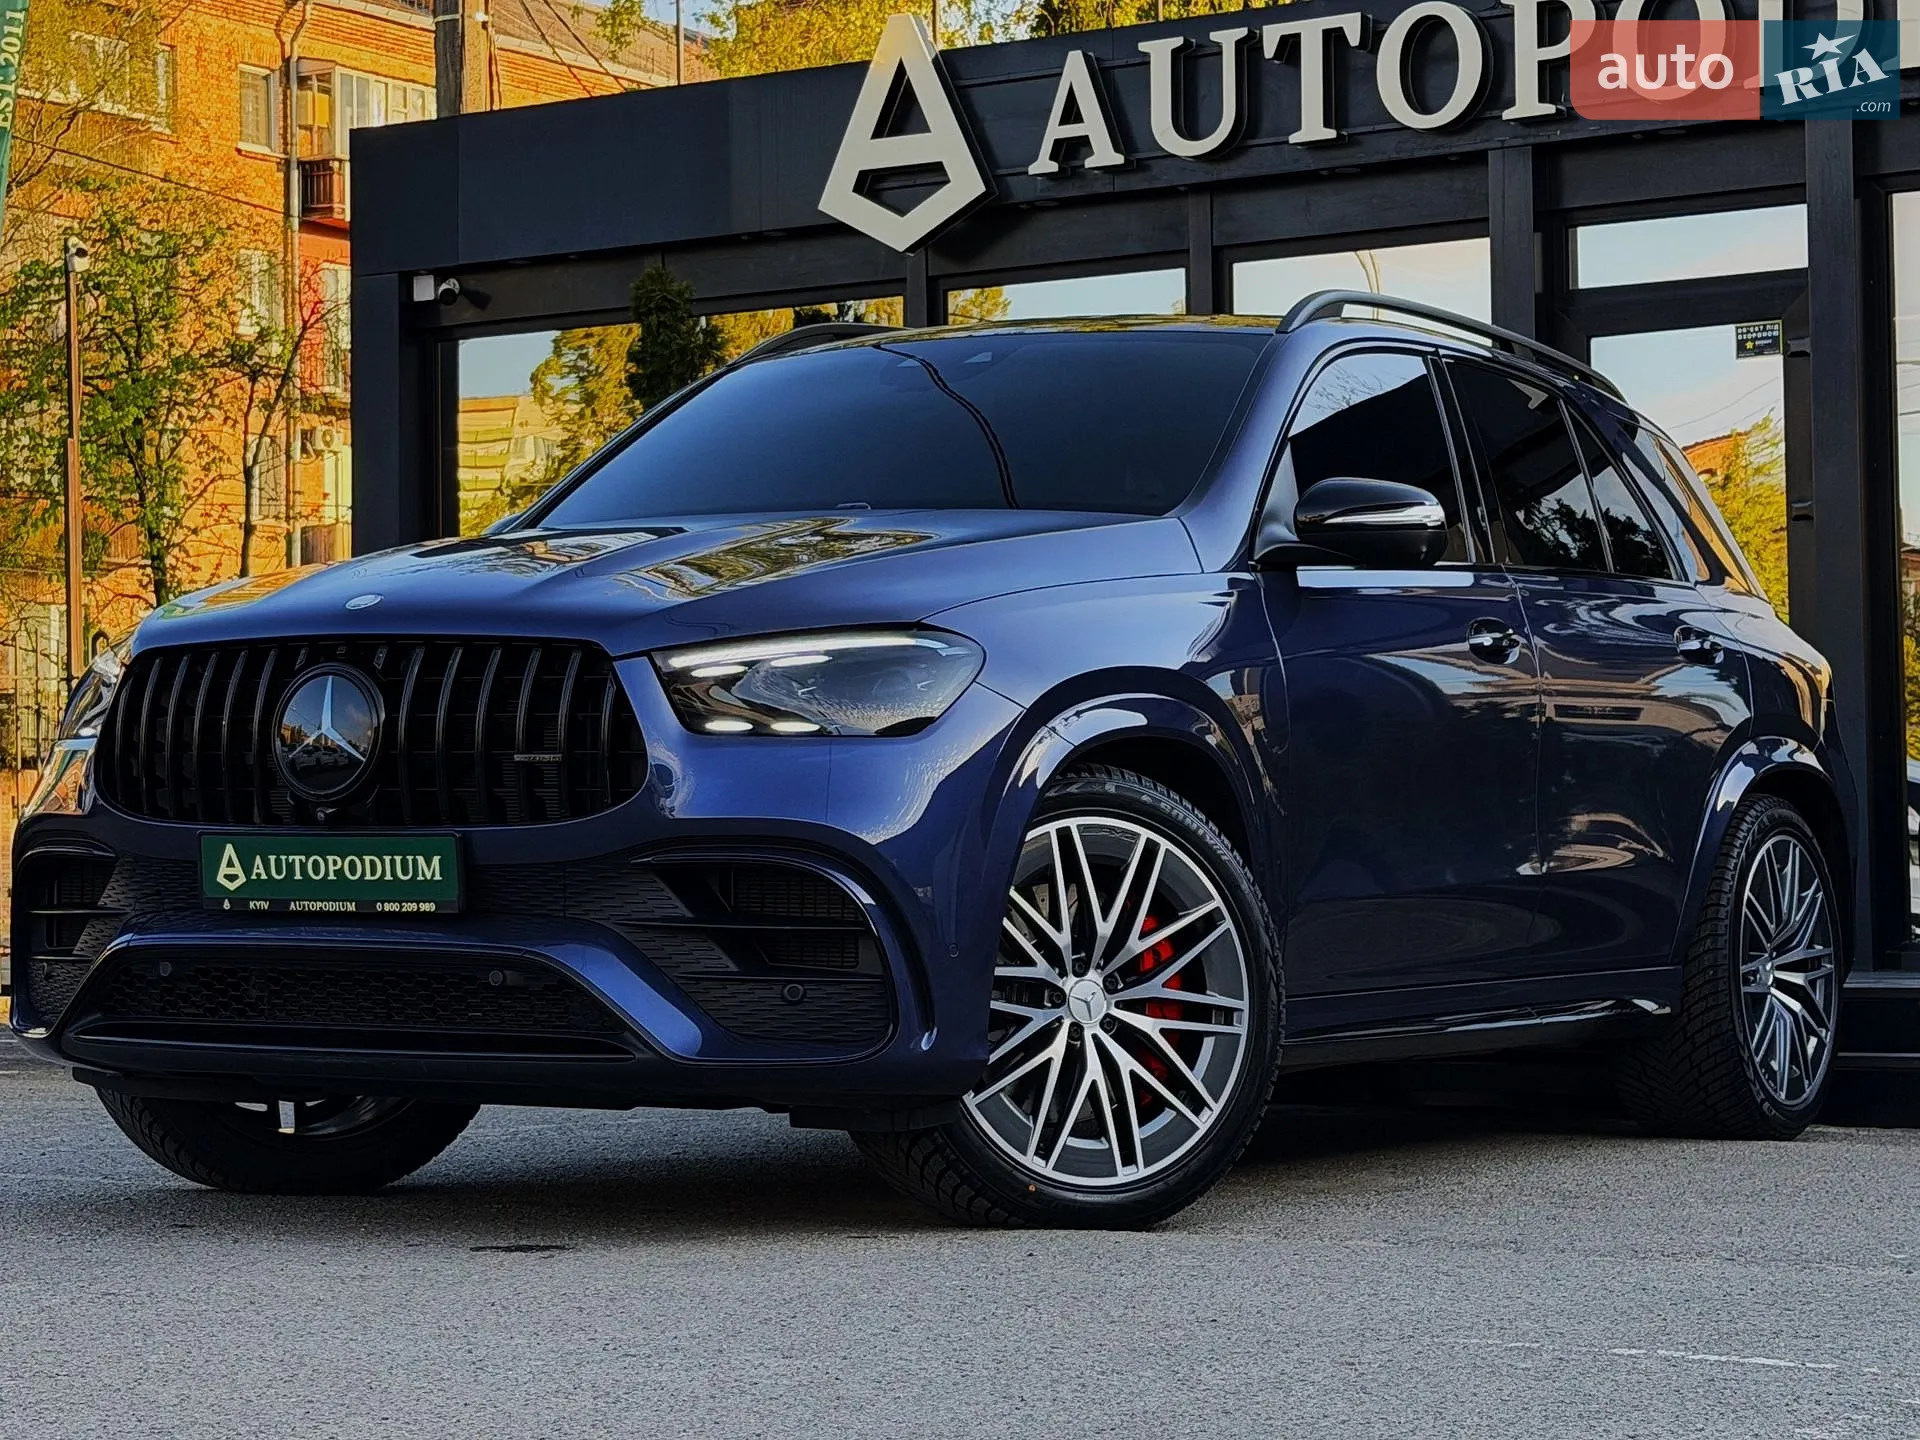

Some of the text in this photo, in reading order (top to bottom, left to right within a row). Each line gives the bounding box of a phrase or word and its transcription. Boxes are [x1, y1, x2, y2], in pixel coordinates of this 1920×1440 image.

[0, 10, 25, 69] 2011
[251, 854, 442, 881] AUTOPODIUM
[249, 900, 435, 912] KYIV AUTOPODIUM 0 800 209 989
